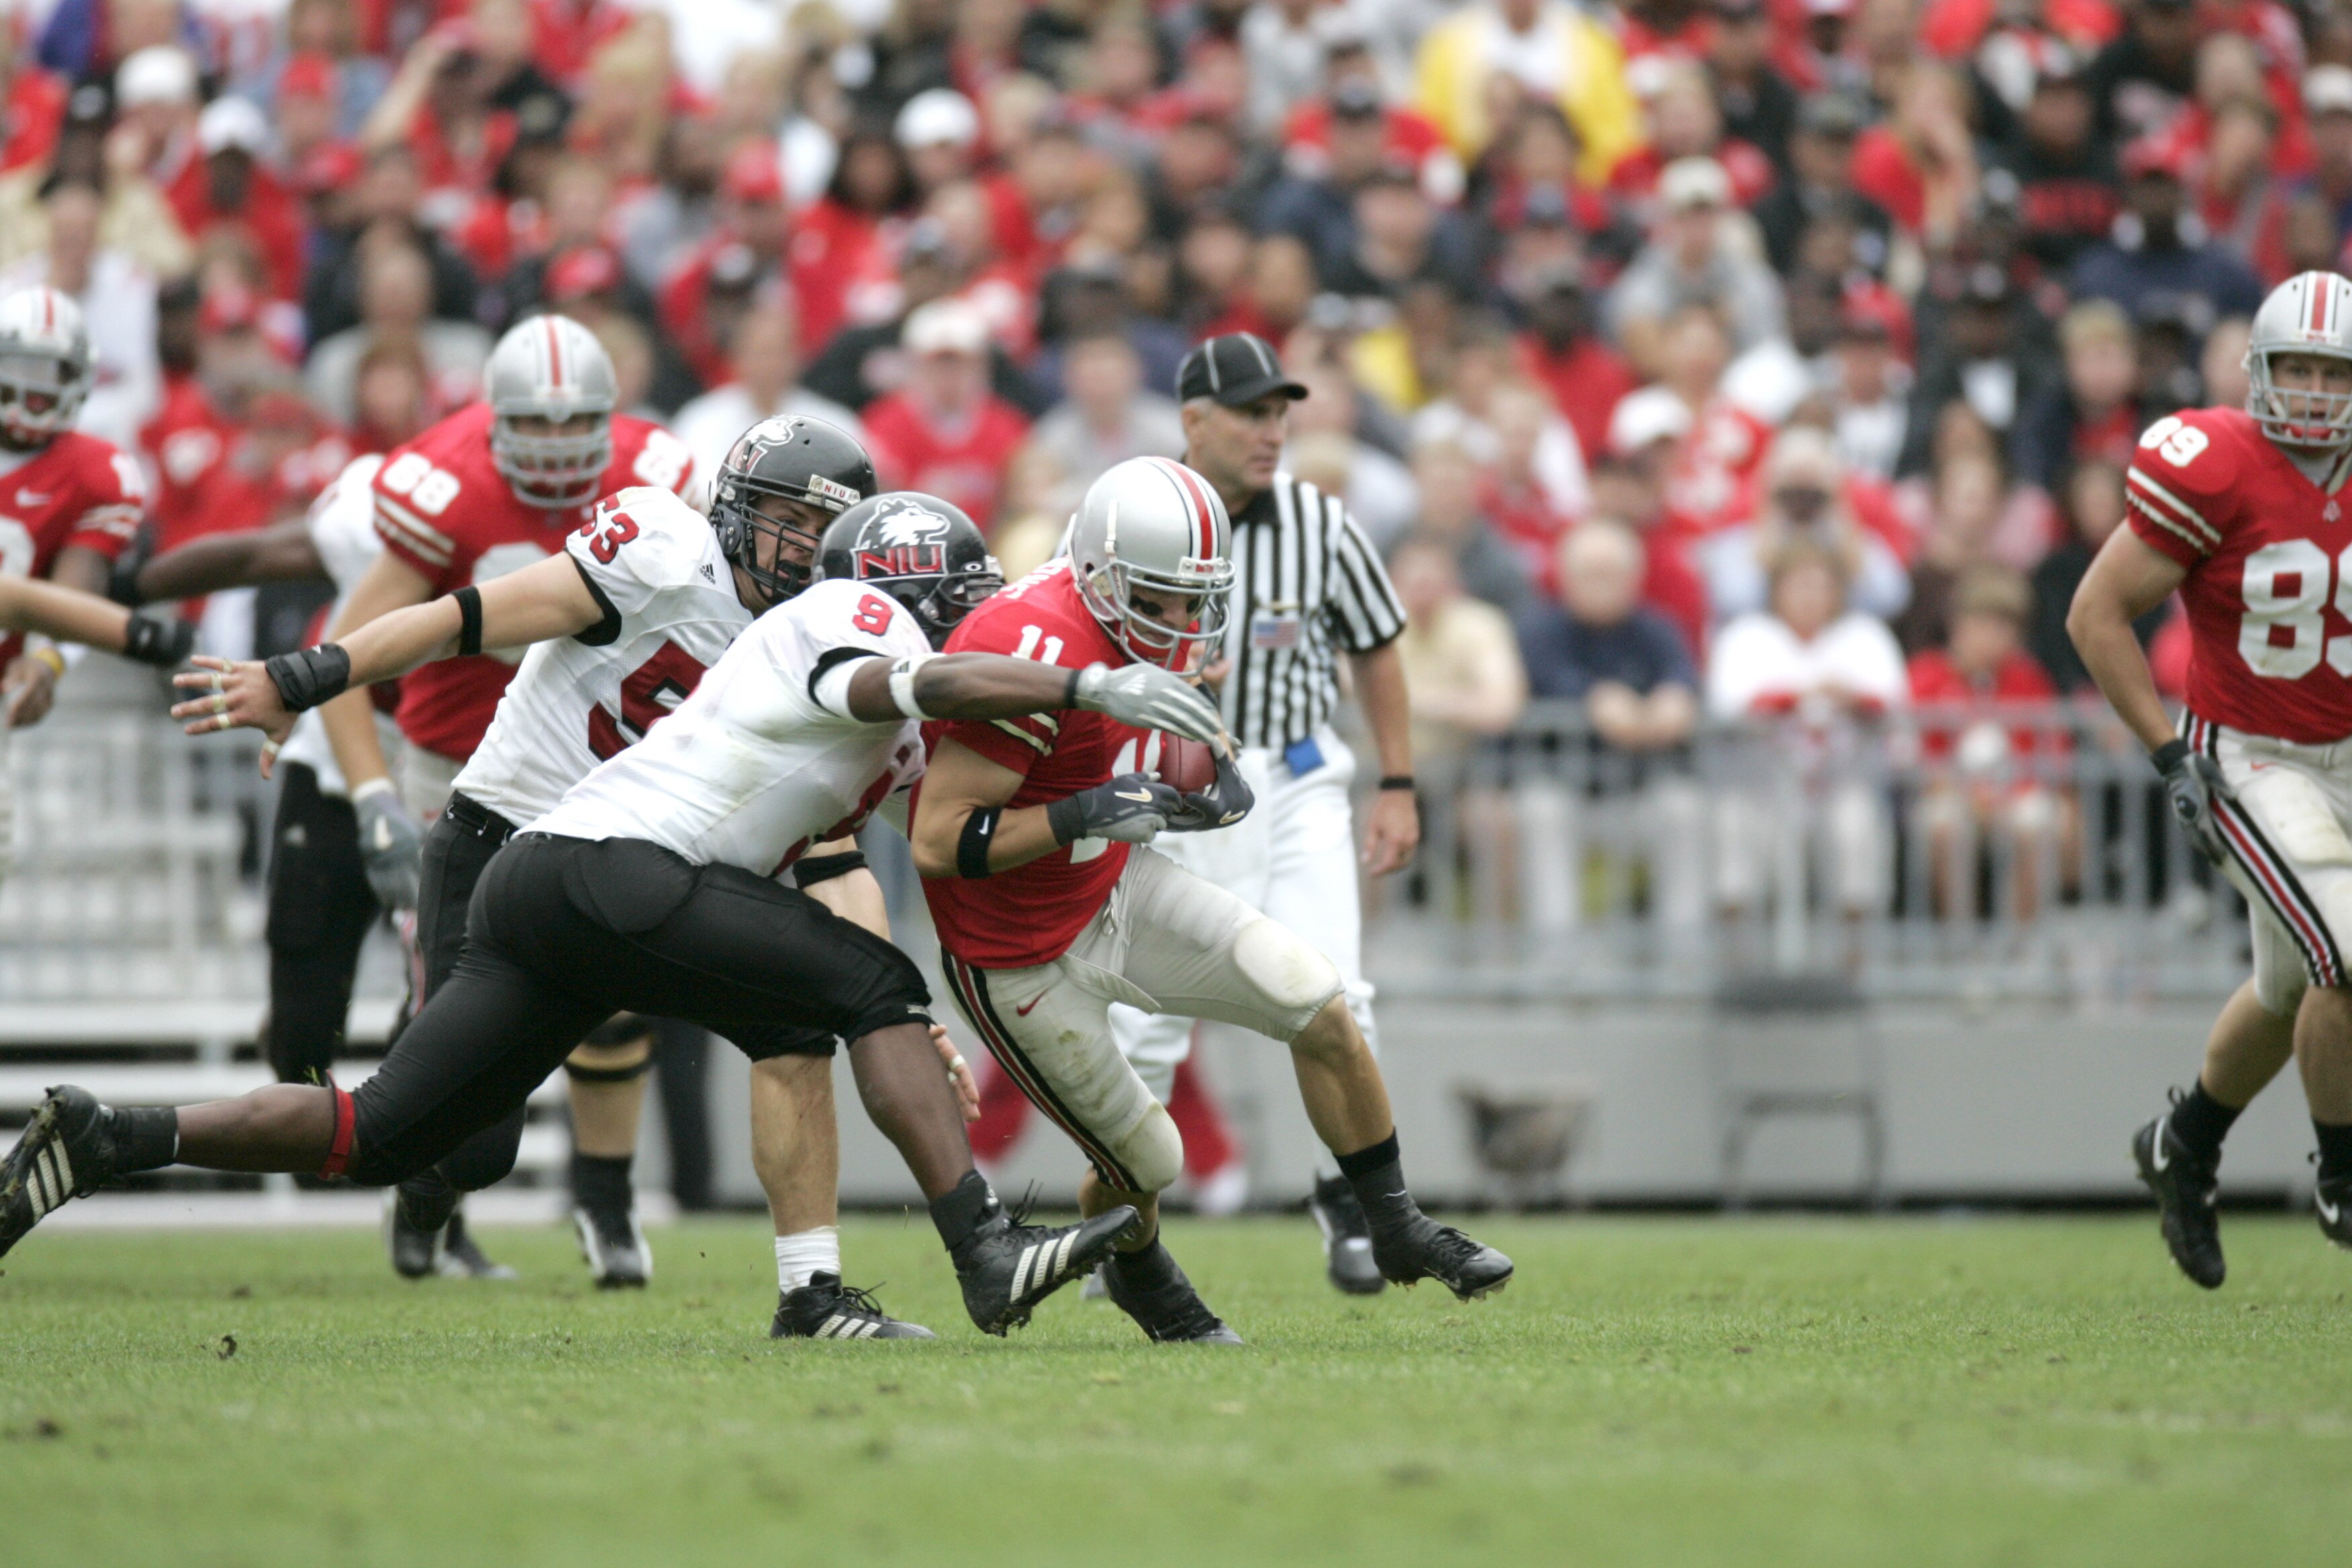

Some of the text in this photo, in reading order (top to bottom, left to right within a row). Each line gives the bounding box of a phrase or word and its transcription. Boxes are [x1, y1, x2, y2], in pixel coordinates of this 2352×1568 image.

[2139, 415, 2210, 468] 89
[824, 484, 846, 498] NIU
[858, 545, 941, 579] NIU
[852, 593, 895, 637] 9
[1012, 624, 1065, 666] 11
